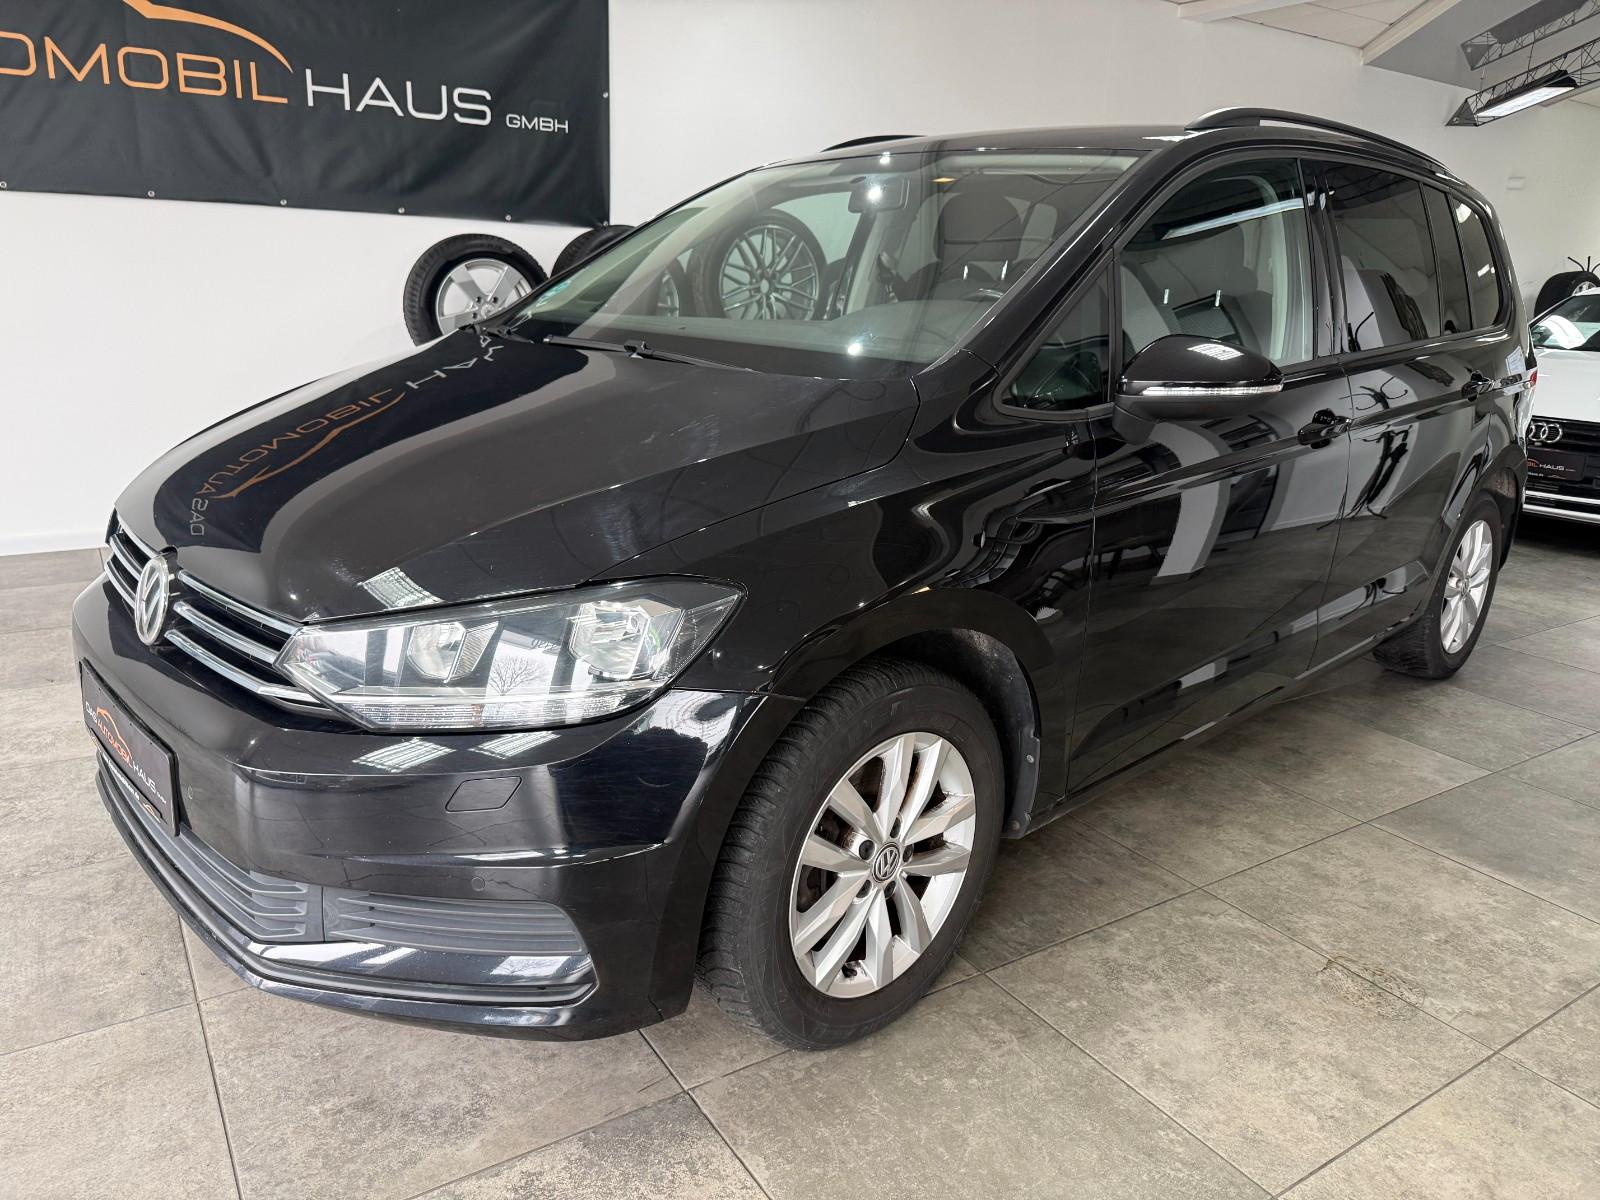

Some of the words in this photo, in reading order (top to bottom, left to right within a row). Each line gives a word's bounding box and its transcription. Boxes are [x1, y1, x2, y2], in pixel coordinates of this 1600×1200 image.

[305, 68, 492, 126] HAUS
[505, 113, 569, 134] GMBH
[132, 760, 157, 794] HAUS
